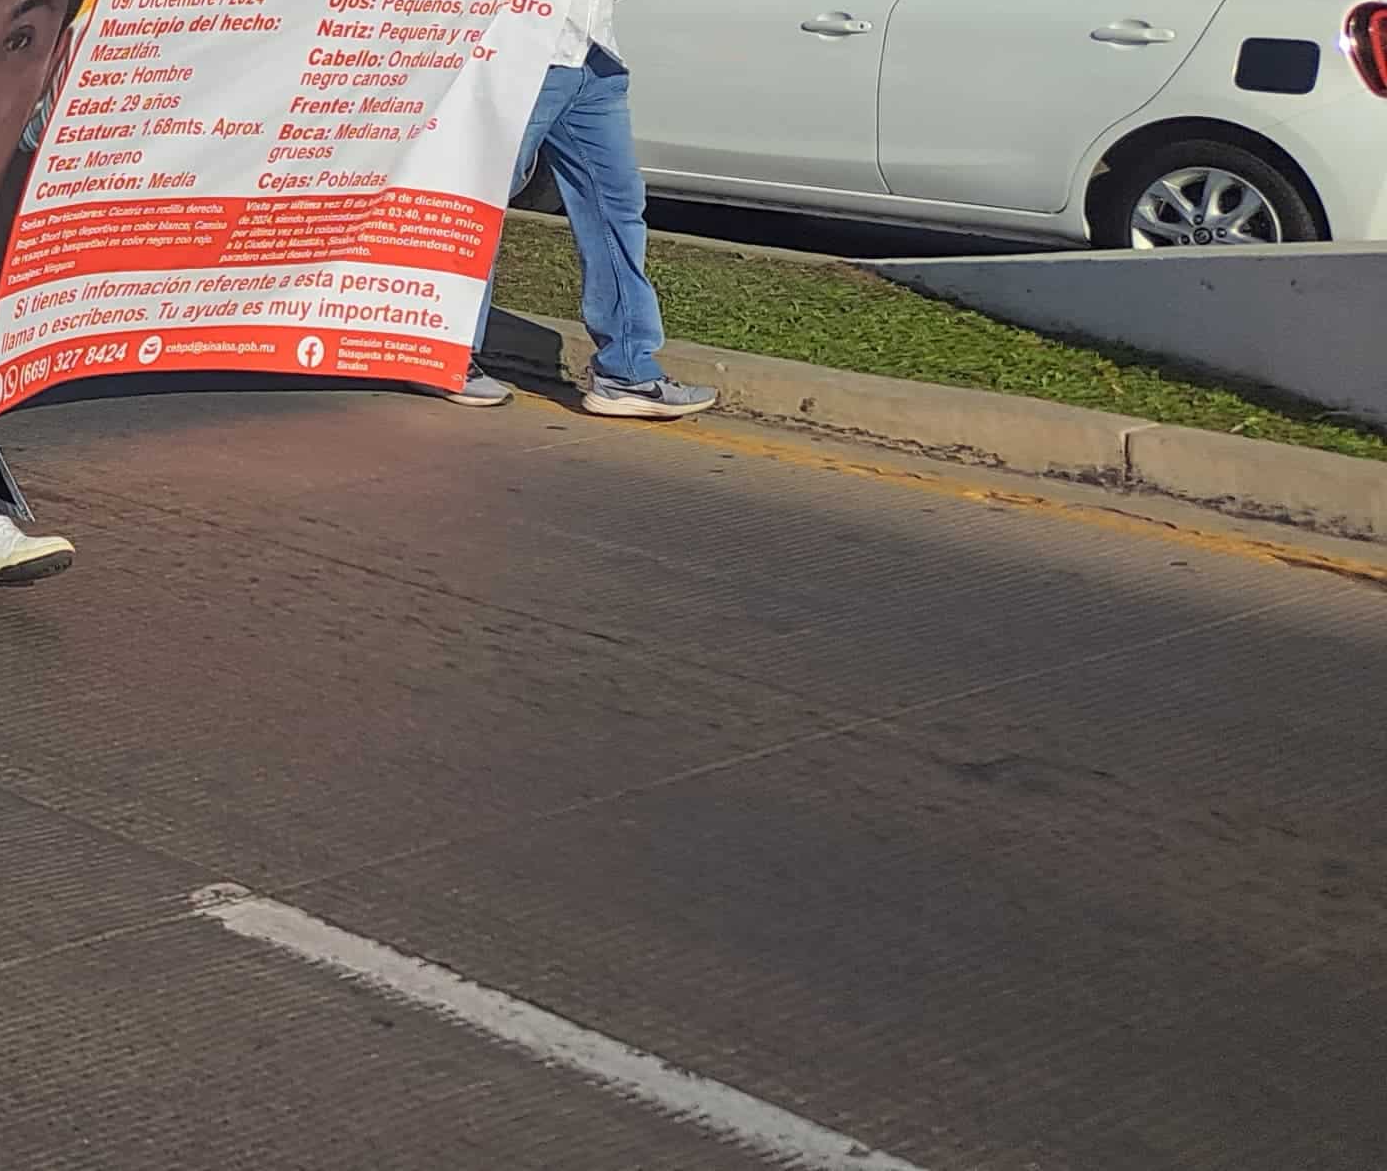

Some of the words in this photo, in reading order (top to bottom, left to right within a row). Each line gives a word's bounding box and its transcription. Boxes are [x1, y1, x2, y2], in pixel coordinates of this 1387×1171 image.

[99, 16, 185, 39] Municipio
[188, 14, 219, 33] del
[219, 14, 282, 32] hecho:
[316, 18, 375, 39] Nariz:
[378, 22, 445, 43] Pequeña
[446, 27, 460, 46] y
[90, 40, 162, 63] Mazatlán.
[308, 48, 385, 68] Cabello:
[387, 50, 464, 70] Ondulado
[78, 69, 127, 89] Sexo:
[130, 64, 194, 85] Hombre
[300, 72, 349, 90] negro
[352, 72, 408, 87] canoso
[66, 97, 117, 117] Edad:
[120, 94, 141, 113] 29
[142, 92, 181, 111] años
[289, 96, 356, 114] Frente:
[358, 96, 424, 114] Mediana
[55, 123, 136, 145] Estatura:
[141, 118, 207, 136] 1.68mts.
[210, 117, 265, 140] Aprox.
[278, 123, 331, 141] Boca:
[334, 123, 401, 143] Mediana,
[46, 154, 81, 174] Tez:
[84, 148, 143, 169] Moreno
[267, 145, 333, 163] gruesos
[35, 173, 143, 200] Complexión:
[147, 172, 197, 190] Media
[257, 172, 313, 193] Cejas:
[316, 171, 388, 188] Pobladas
[398, 193, 412, 203] de
[414, 193, 475, 214] diciembre
[424, 212, 438, 222] se
[459, 246, 475, 258] su
[14, 297, 28, 320] Si
[31, 287, 78, 312] tienes
[81, 277, 191, 301] información
[194, 273, 277, 293] referente
[278, 275, 291, 289] a
[294, 269, 333, 288] esta
[340, 274, 442, 302] persona,
[0, 327, 35, 355] llama
[38, 322, 48, 338] o
[51, 305, 150, 334] escribenos.
[157, 301, 180, 321] Tu
[182, 299, 239, 323] ayuda
[242, 299, 263, 316] es
[268, 299, 312, 322] muy
[318, 298, 450, 331] importante.
[19, 355, 52, 386] (669)
[53, 348, 83, 373] 327
[84, 341, 129, 366] 8424
